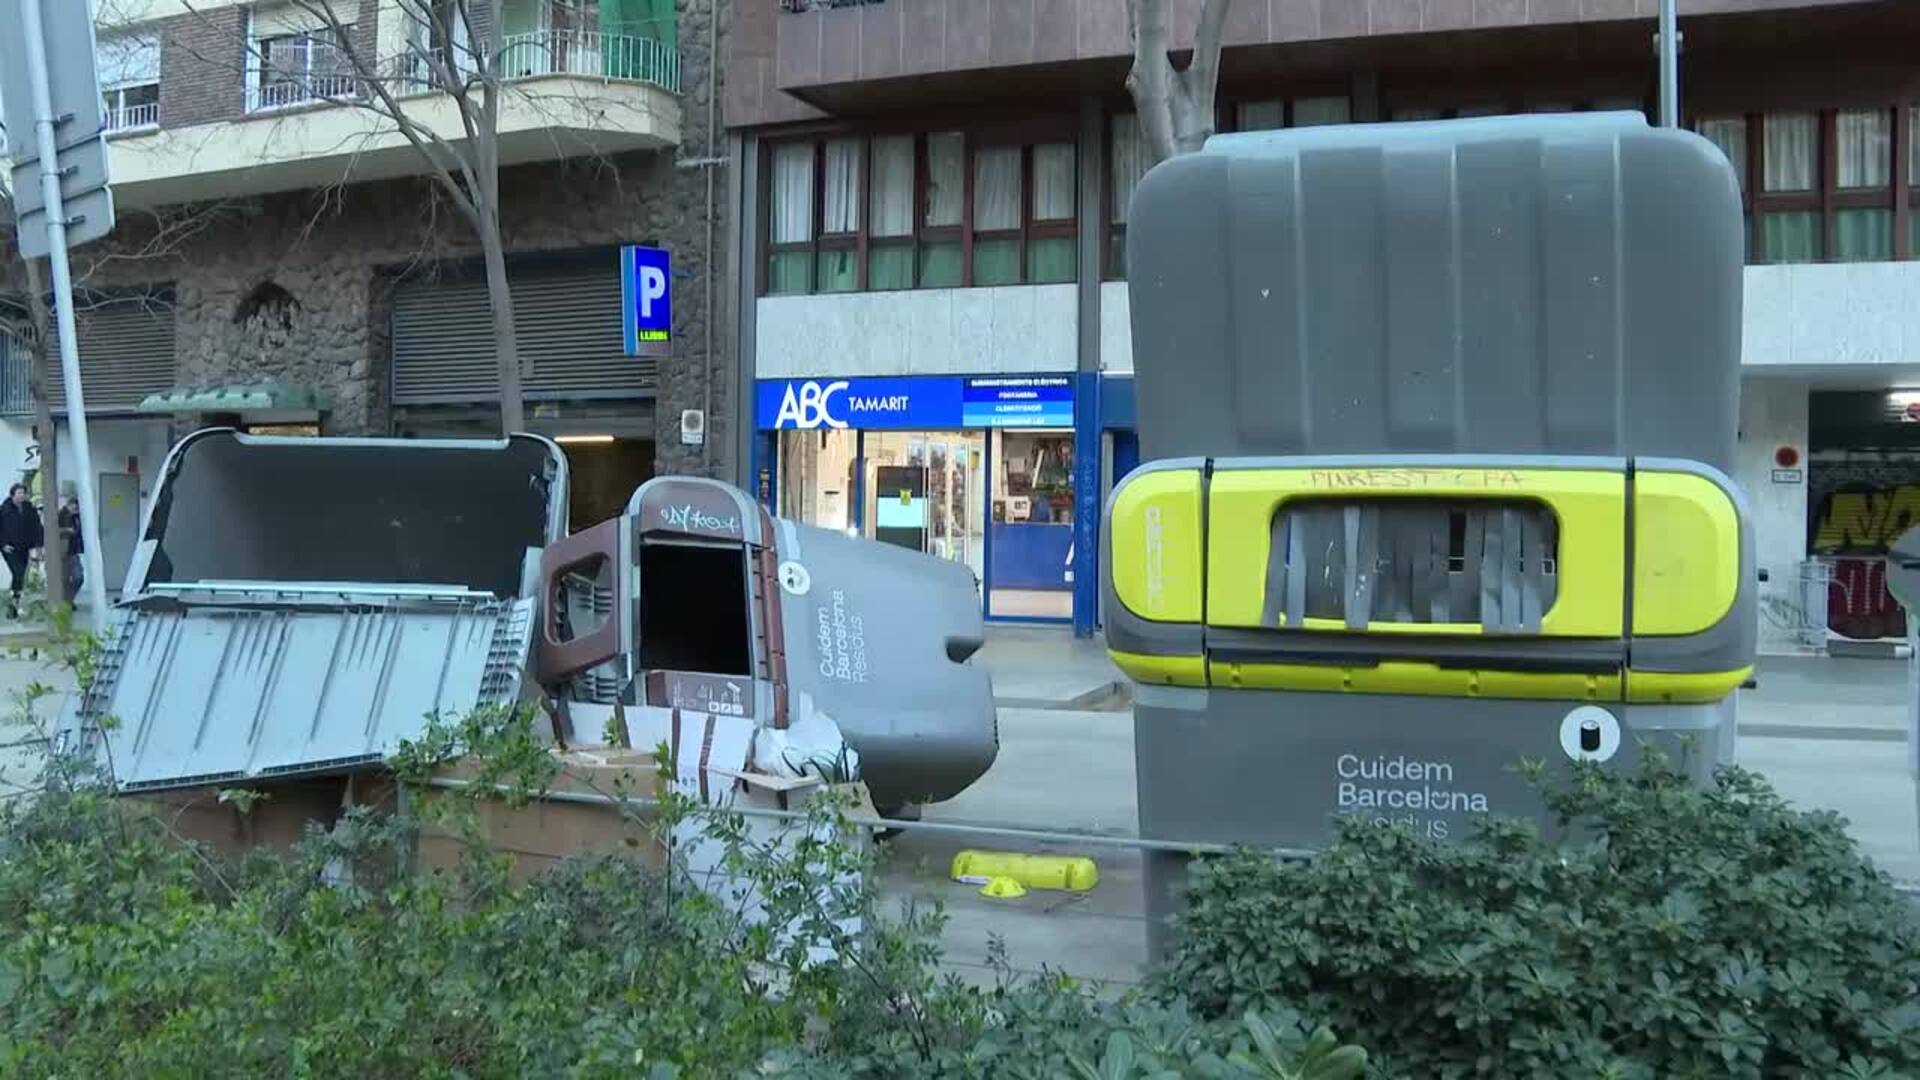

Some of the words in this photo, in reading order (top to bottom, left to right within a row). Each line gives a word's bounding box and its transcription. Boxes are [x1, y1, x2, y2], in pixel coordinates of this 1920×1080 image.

[640, 266, 665, 317] P
[775, 381, 849, 429] ABC
[848, 395, 909, 412] TAMARIT
[816, 607, 834, 677] Cuidem
[1337, 754, 1453, 781] Cuidem
